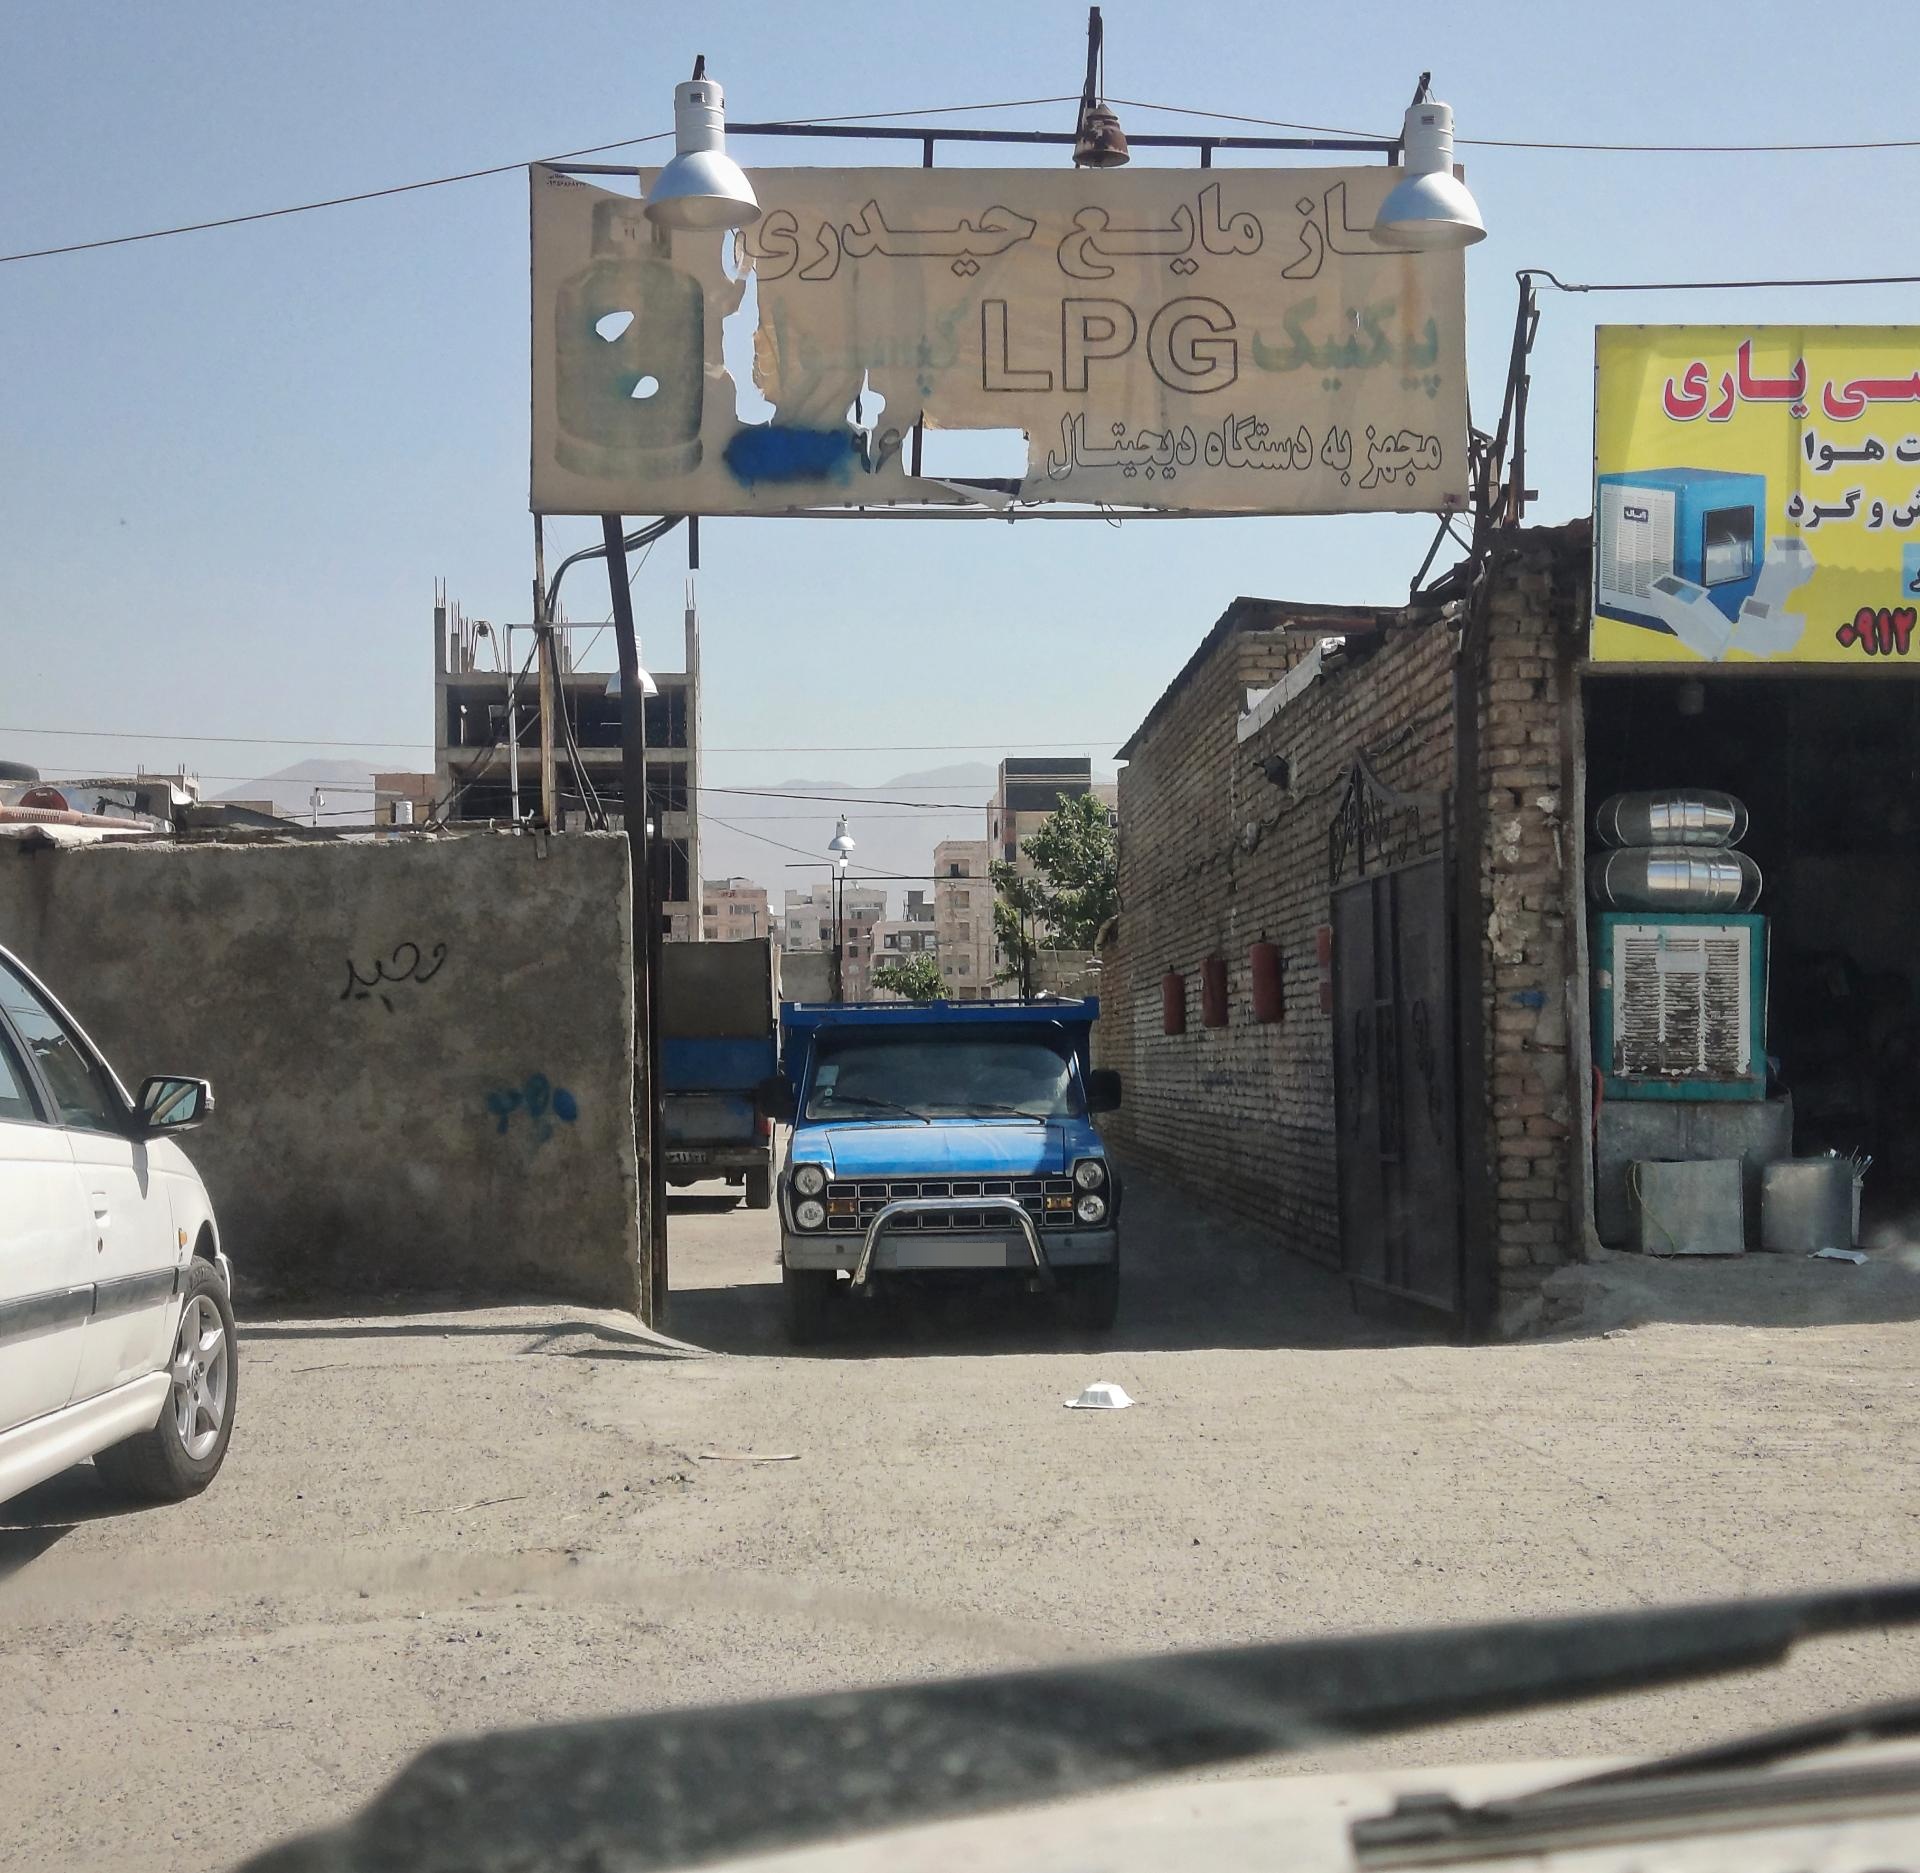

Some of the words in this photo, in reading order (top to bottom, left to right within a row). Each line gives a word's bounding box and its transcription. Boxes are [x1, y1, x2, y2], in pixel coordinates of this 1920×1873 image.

[734, 199, 1037, 281] حیدری
[1056, 181, 1263, 279] مایع
[1281, 181, 1424, 279] از
[982, 297, 1238, 394] LPG
[1664, 339, 1808, 418] یاری
[1048, 412, 1197, 480] دیجیتال
[1204, 413, 1313, 470] دستگاه
[1321, 425, 1352, 486] به
[1359, 425, 1442, 488] مجهز
[1805, 431, 1884, 471] هوا
[1788, 489, 1860, 527] گرد
[1868, 502, 1883, 527] و
[1835, 606, 1917, 656] ۰۹۱۲
